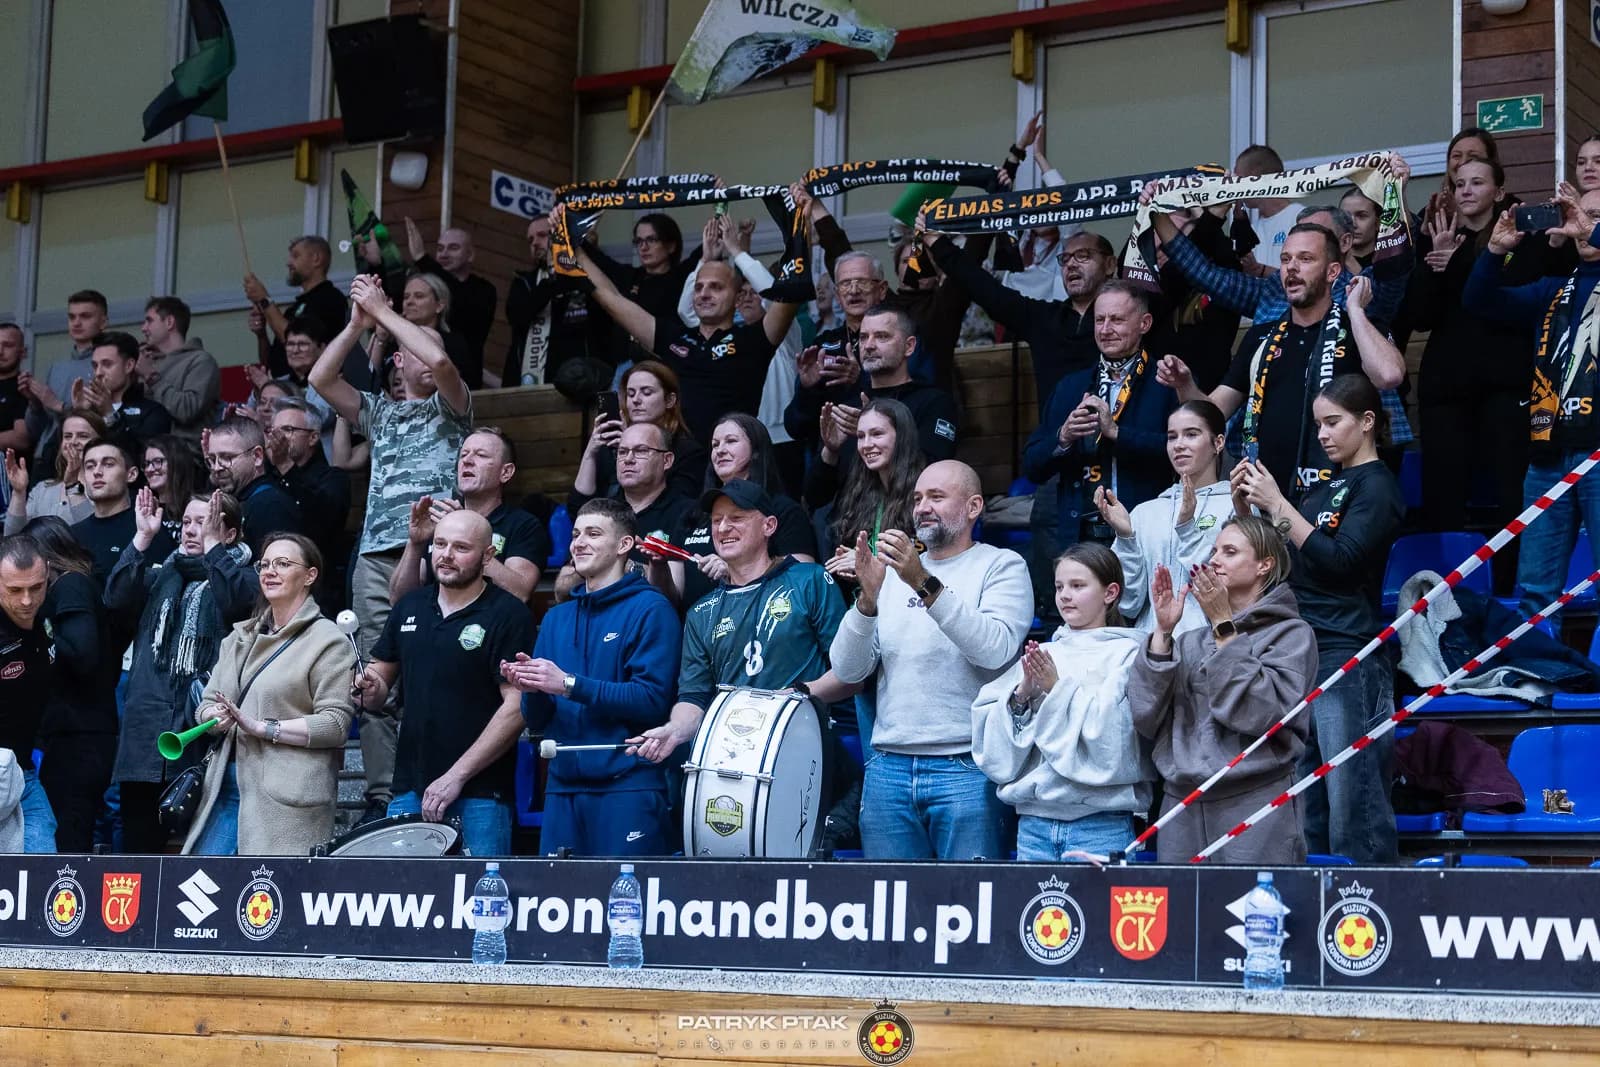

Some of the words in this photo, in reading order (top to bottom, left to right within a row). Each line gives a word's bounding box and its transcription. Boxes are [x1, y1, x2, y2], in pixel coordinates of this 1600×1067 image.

[740, 0, 840, 29] WILCZA
[519, 183, 553, 201] SEKT
[813, 182, 841, 197] Liga
[842, 171, 908, 188] Centralna
[913, 169, 961, 183] Kobiet
[1181, 191, 1210, 205] Liga
[1215, 185, 1290, 200] Centralna
[934, 199, 1004, 221] ELMAS
[1020, 191, 1063, 210] KPS
[1073, 183, 1118, 203] APR
[981, 217, 1013, 231] Liga
[1018, 207, 1094, 226] Centralna
[1100, 200, 1142, 216] Kobi
[1127, 269, 1143, 281] APR
[712, 342, 737, 358] KPS
[1560, 396, 1593, 416] KPS
[1317, 511, 1341, 528] KPS
[105, 896, 133, 926] CK
[1040, 896, 1066, 907] SUZUKI
[1341, 903, 1370, 915] SUZUKI
[301, 873, 993, 965] www.kronhandball.pl
[173, 927, 219, 939] SUZUKI
[1115, 914, 1157, 952] CK
[1025, 932, 1049, 959] KORONA
[1048, 932, 1079, 960] HANDBALL
[1326, 942, 1352, 969] KORONA
[1352, 942, 1386, 970] HANDBALL
